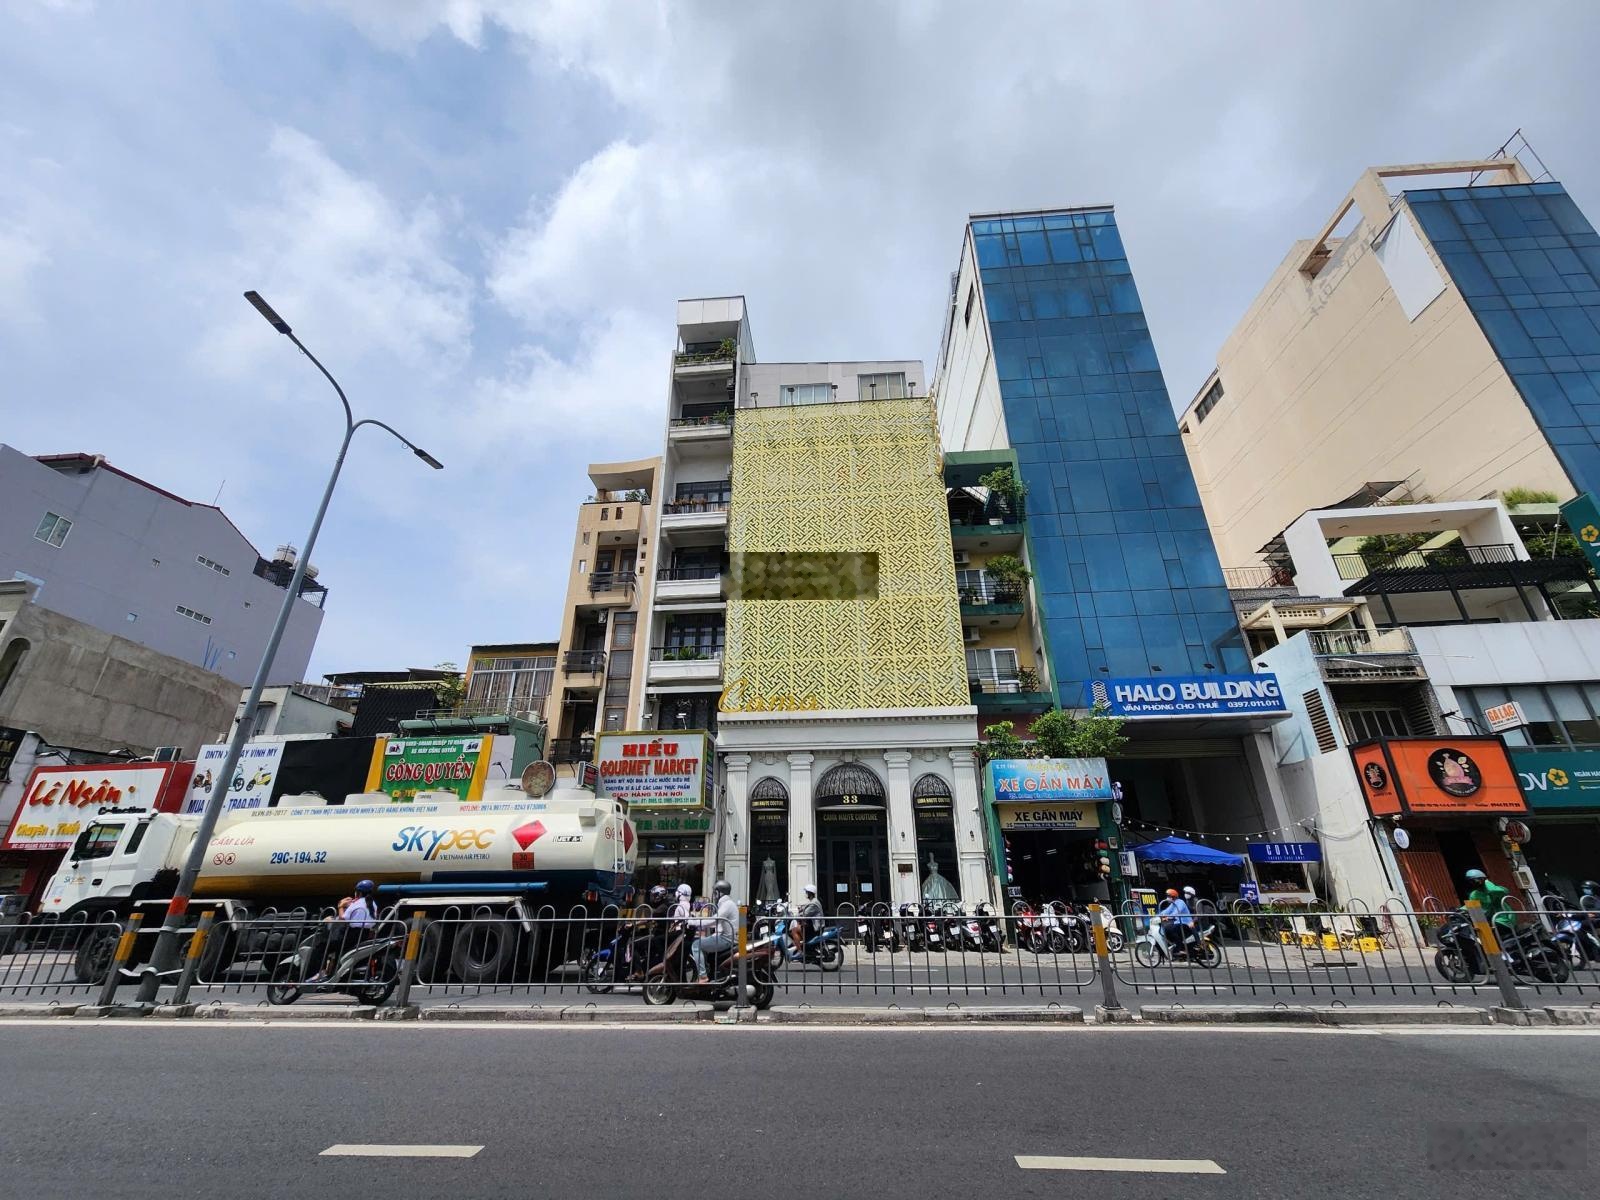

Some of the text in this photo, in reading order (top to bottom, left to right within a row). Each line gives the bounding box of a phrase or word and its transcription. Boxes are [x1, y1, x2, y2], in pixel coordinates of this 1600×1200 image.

[1115, 680, 1280, 702] HALO BUILDING
[1143, 702, 1174, 711] PHÒNG
[1227, 699, 1280, 709] 0397.011.011
[205, 750, 223, 760] DNTN
[386, 758, 423, 781] CÔNG
[601, 760, 650, 777] GOURMET
[653, 758, 698, 775] MARKET
[1000, 778, 1021, 792] XE
[1066, 774, 1104, 790] MÁY
[29, 779, 122, 808] Lê Ngân
[843, 795, 858, 804] 33
[187, 800, 206, 814] MUA
[426, 805, 438, 813] NAM
[1014, 811, 1030, 821] XE
[1060, 808, 1083, 821] MÁY
[270, 851, 327, 864] 29C-194.32
[1142, 894, 1158, 905] MUA
